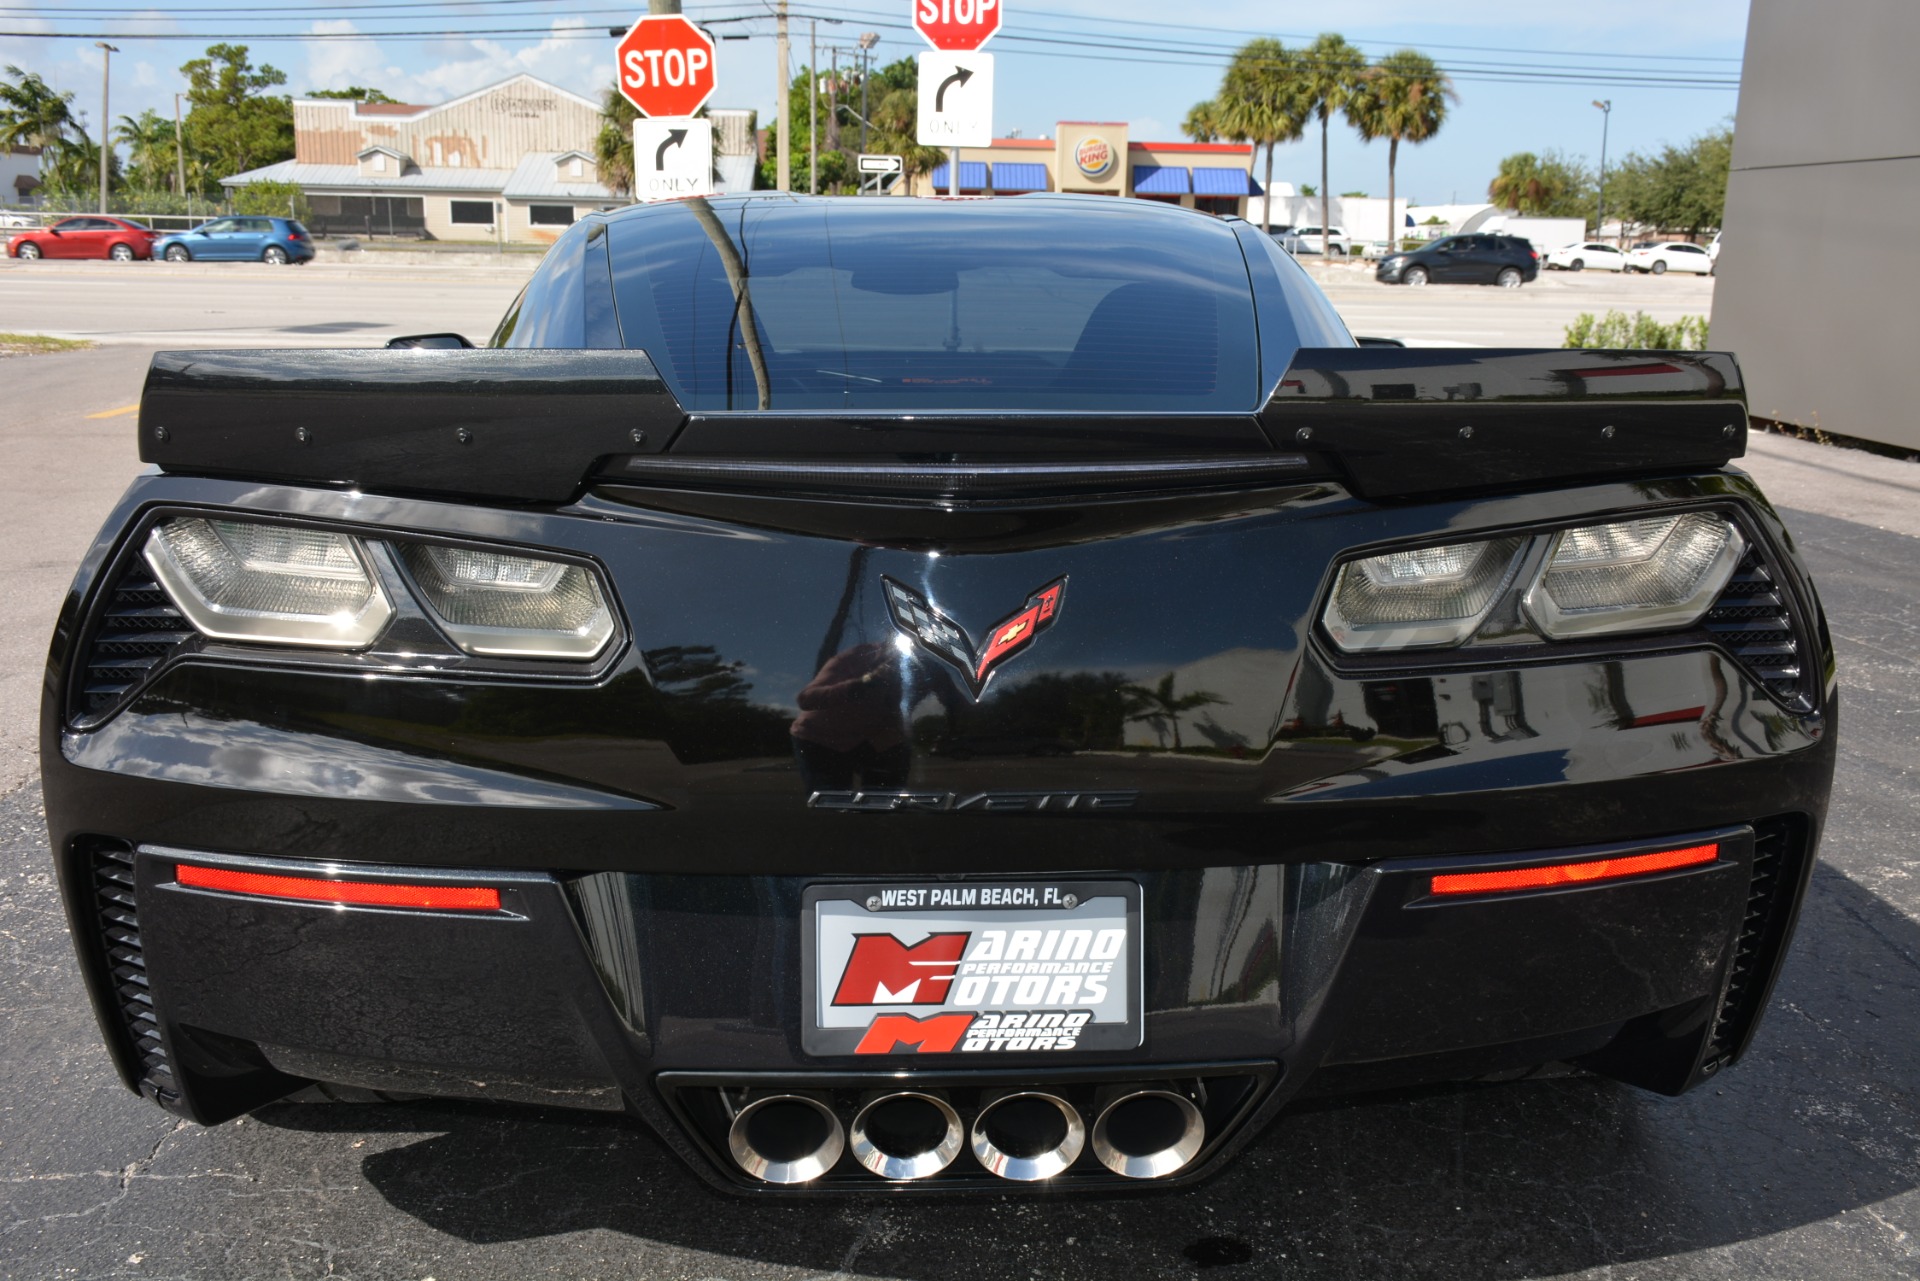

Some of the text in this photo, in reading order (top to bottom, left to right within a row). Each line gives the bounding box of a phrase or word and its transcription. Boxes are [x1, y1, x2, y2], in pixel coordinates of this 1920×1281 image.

[918, 0, 996, 25] STOP
[624, 48, 708, 89] STOP
[1080, 150, 1108, 167] KING
[649, 177, 698, 193] ONLY
[807, 789, 1140, 811] CORVETTE
[881, 888, 1062, 907] WEST PALM BEACH, FL
[961, 960, 1114, 975] PERFORMANCE
[966, 1027, 1082, 1038] PERFORMANCE
